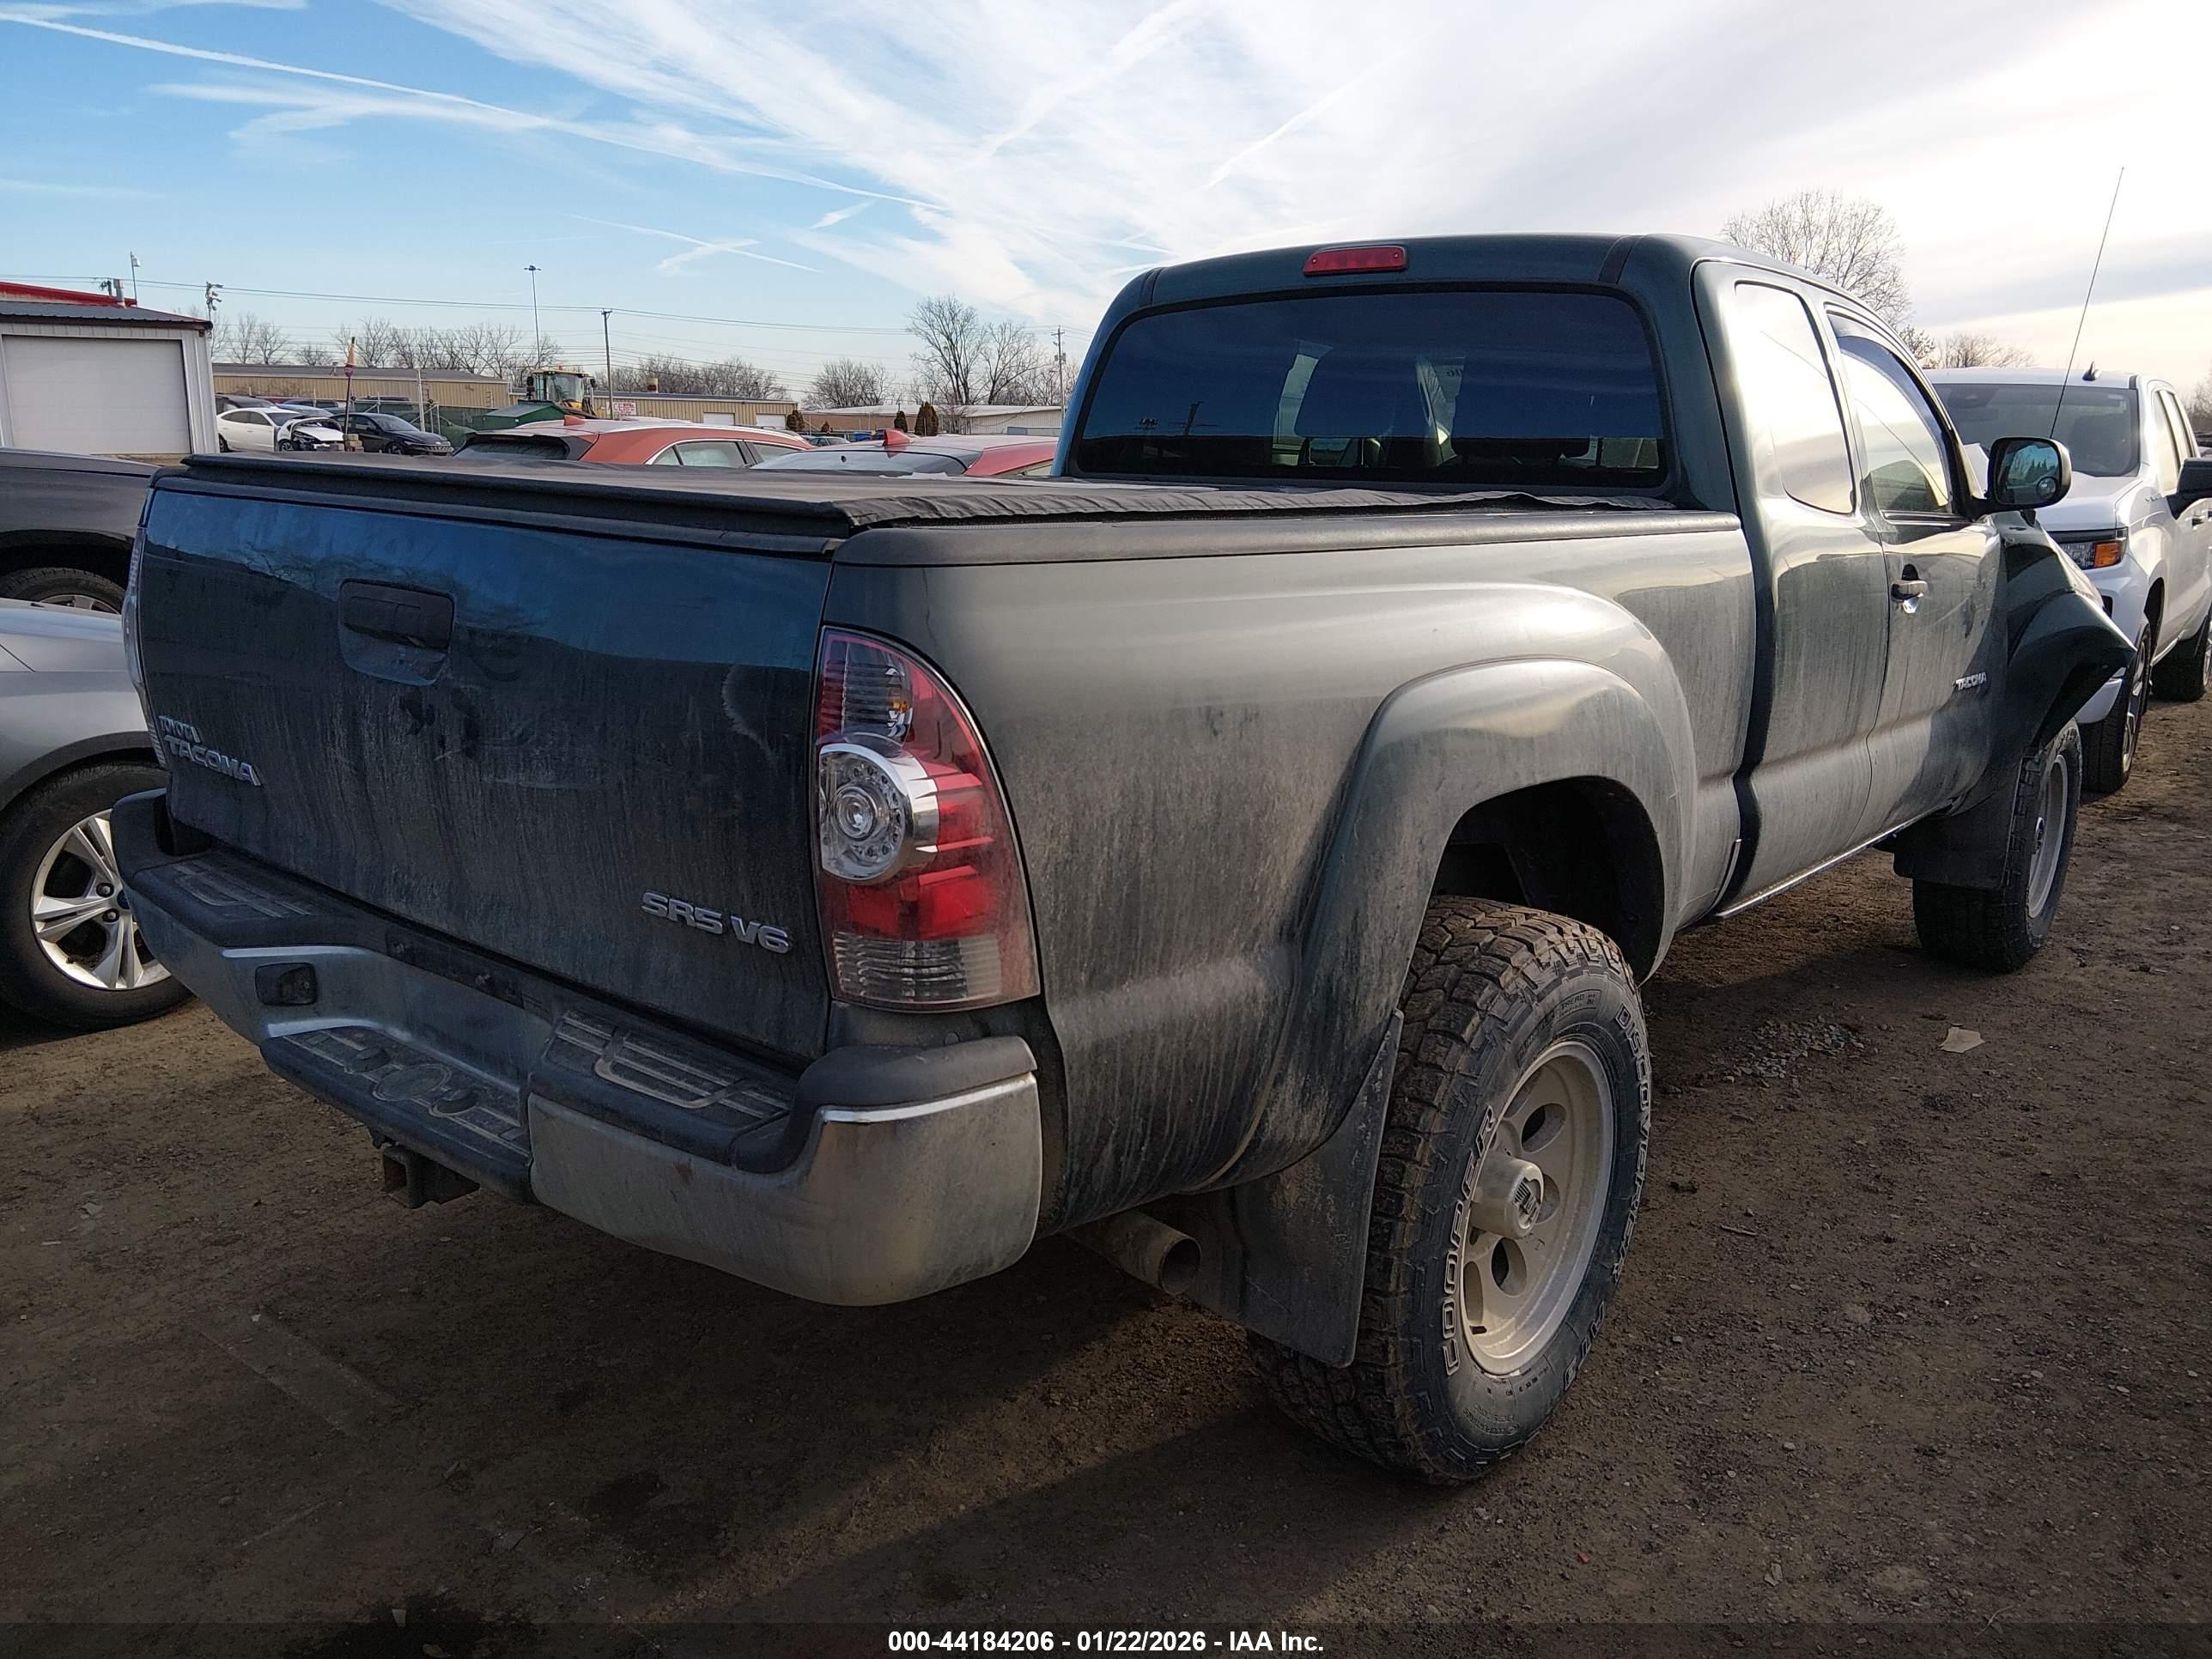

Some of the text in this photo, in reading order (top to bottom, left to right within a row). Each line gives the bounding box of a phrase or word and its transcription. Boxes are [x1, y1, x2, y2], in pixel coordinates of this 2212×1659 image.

[1956, 672, 1986, 690] TACOMA
[164, 734, 261, 786] TACOMA
[641, 891, 789, 954] SR5 V6
[1612, 1003, 1651, 1284] DISCOVERER
[1442, 1104, 1498, 1376] COOPER
